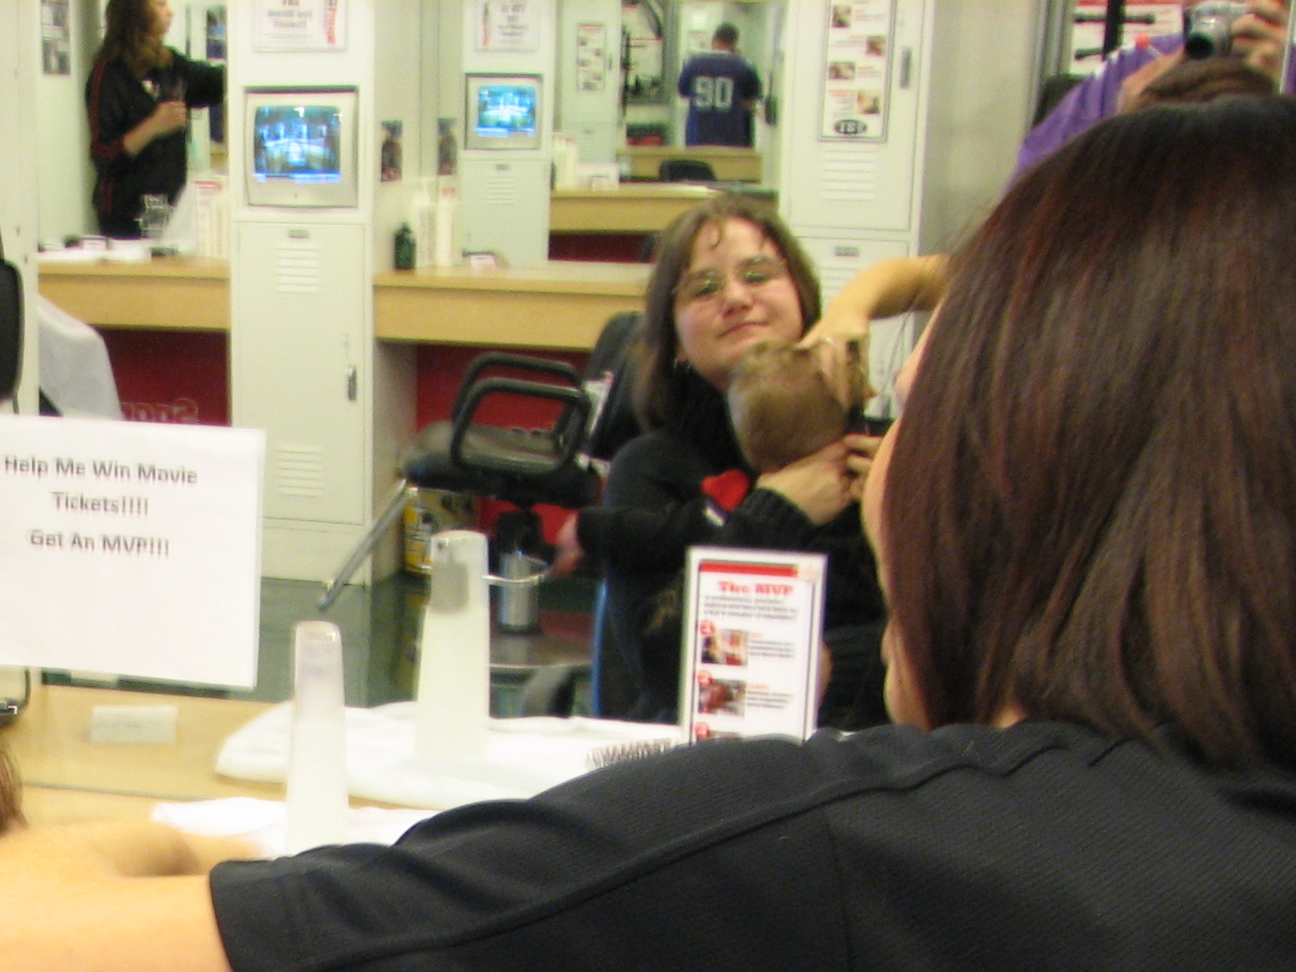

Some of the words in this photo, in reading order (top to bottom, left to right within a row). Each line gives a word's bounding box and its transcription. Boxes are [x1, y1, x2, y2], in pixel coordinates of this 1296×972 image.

[3, 454, 49, 482] Help
[55, 457, 87, 479] Me
[92, 459, 131, 482] Win
[137, 462, 199, 486] Movie
[50, 491, 149, 517] Tickets!!!!
[29, 529, 65, 548] Get
[70, 531, 95, 551] An
[102, 533, 170, 558] MVP!!!
[718, 580, 750, 594] The
[755, 583, 793, 595] MVP
